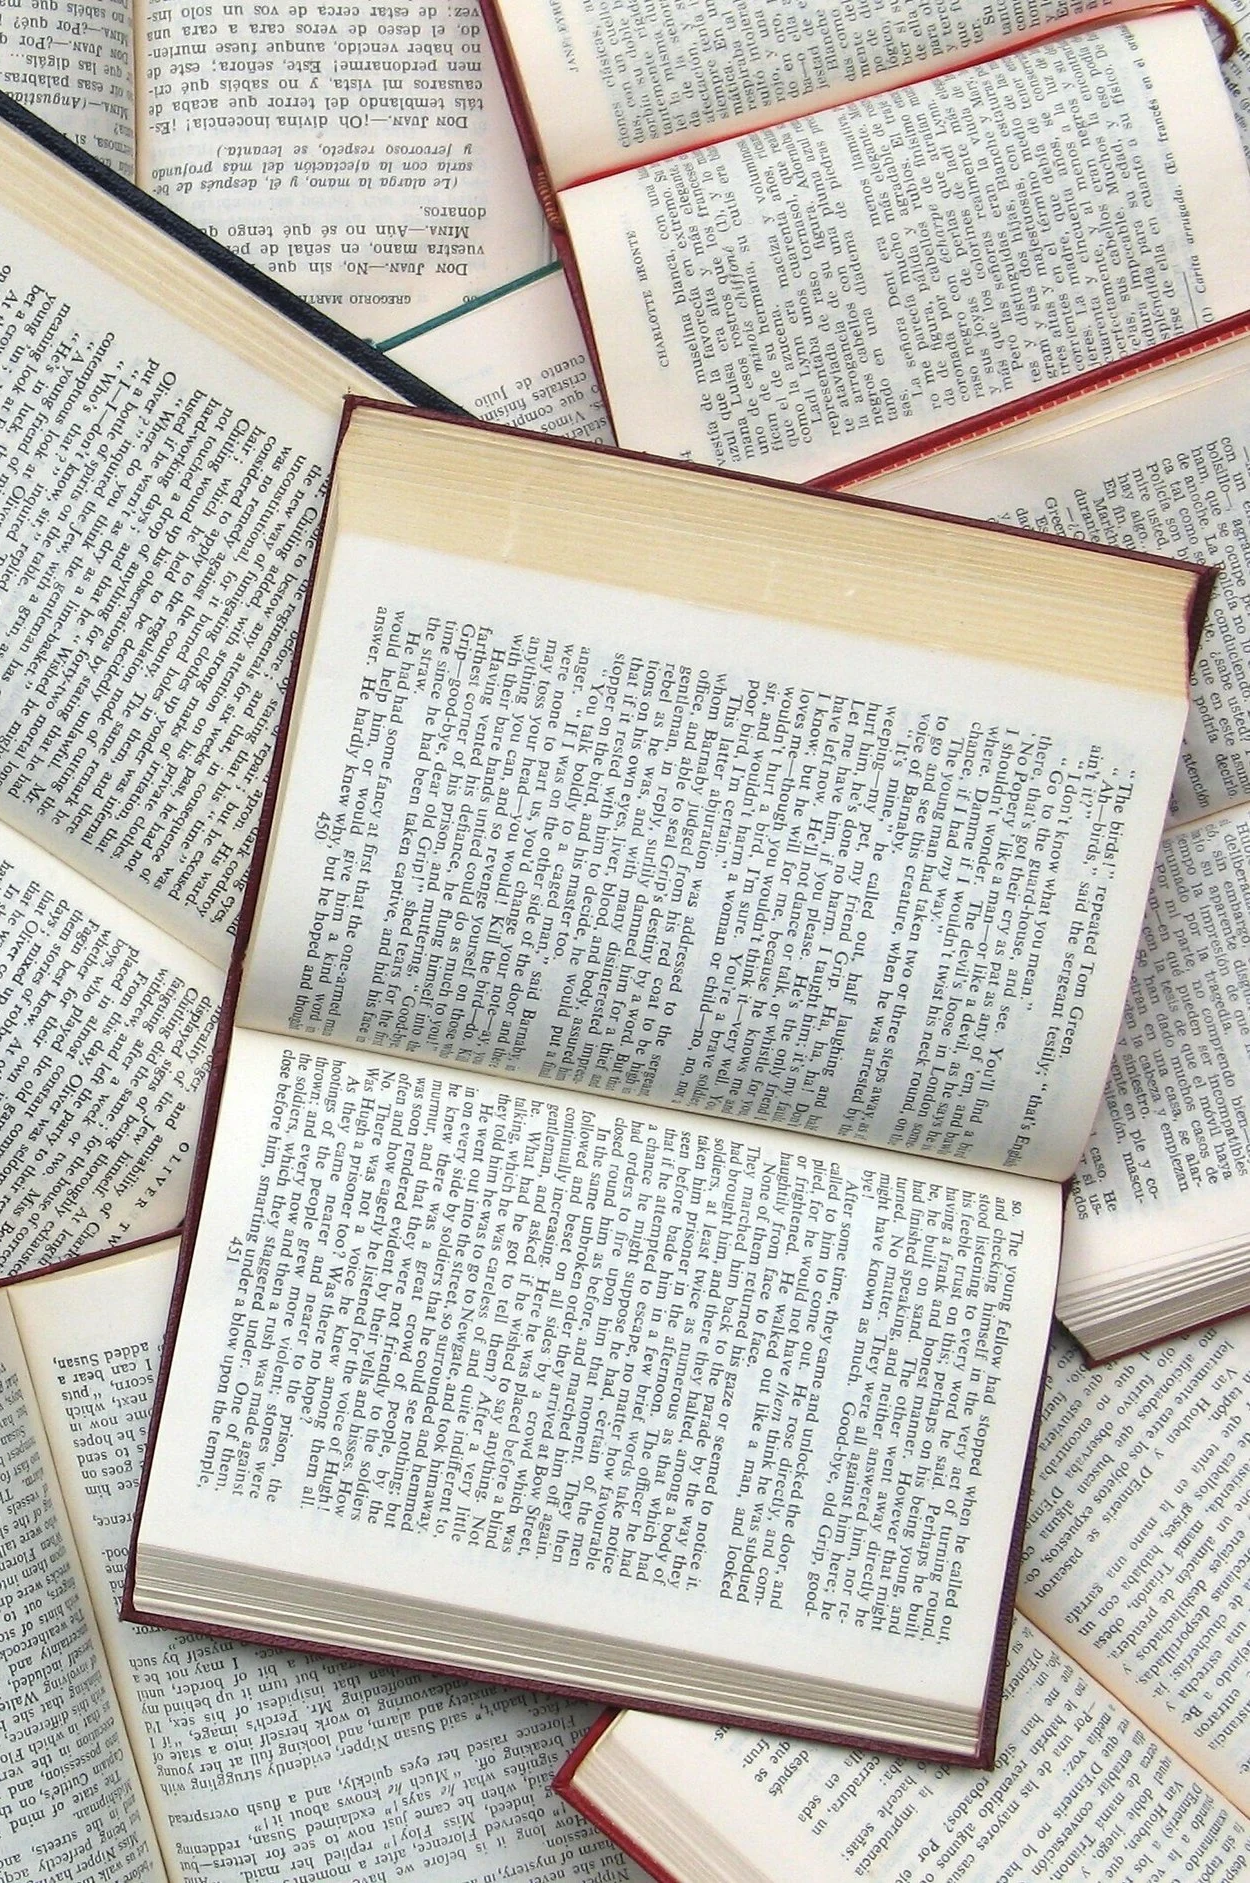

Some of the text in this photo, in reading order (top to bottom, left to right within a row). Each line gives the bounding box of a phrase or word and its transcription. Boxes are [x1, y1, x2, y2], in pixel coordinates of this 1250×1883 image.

[176, 181, 193, 194] de
[200, 176, 258, 192] después
[265, 175, 282, 190] él,
[289, 175, 299, 187] y
[305, 175, 350, 188] mano,
[357, 177, 372, 189] la
[378, 175, 426, 190] alarga
[433, 175, 458, 190] (Le
[267, 260, 297, 273] que
[308, 261, 332, 275] sin
[1172, 184, 1220, 323] (1) Carita arrugada.
[349, 294, 411, 305] GREGORIO
[859, 178, 923, 397] La señora Dent era menos
[642, 289, 670, 368] CHARLOTTE
[54, 331, 115, 425] contemptuous
[474, 354, 586, 408] cuento de Julio
[771, 304, 812, 444] como la azucena.
[34, 429, 60, 459] look
[21, 463, 35, 479] at
[1131, 467, 1170, 550] mire usted,
[413, 616, 441, 694] the straw.
[890, 713, 931, 854] voice of Barnaby.
[314, 811, 331, 840] 450
[1083, 885, 1107, 955] repeated
[1073, 962, 1095, 998] Tom
[1058, 1006, 1084, 1058] Green.
[134, 1141, 190, 1208] OLIVER
[226, 1236, 243, 1263] 451
[1210, 1368, 1238, 1391] Van
[1165, 1397, 1212, 1444] Houben
[1154, 1447, 1164, 1460] y
[1086, 1528, 1100, 1542] se
[1033, 1546, 1084, 1598] pasearon
